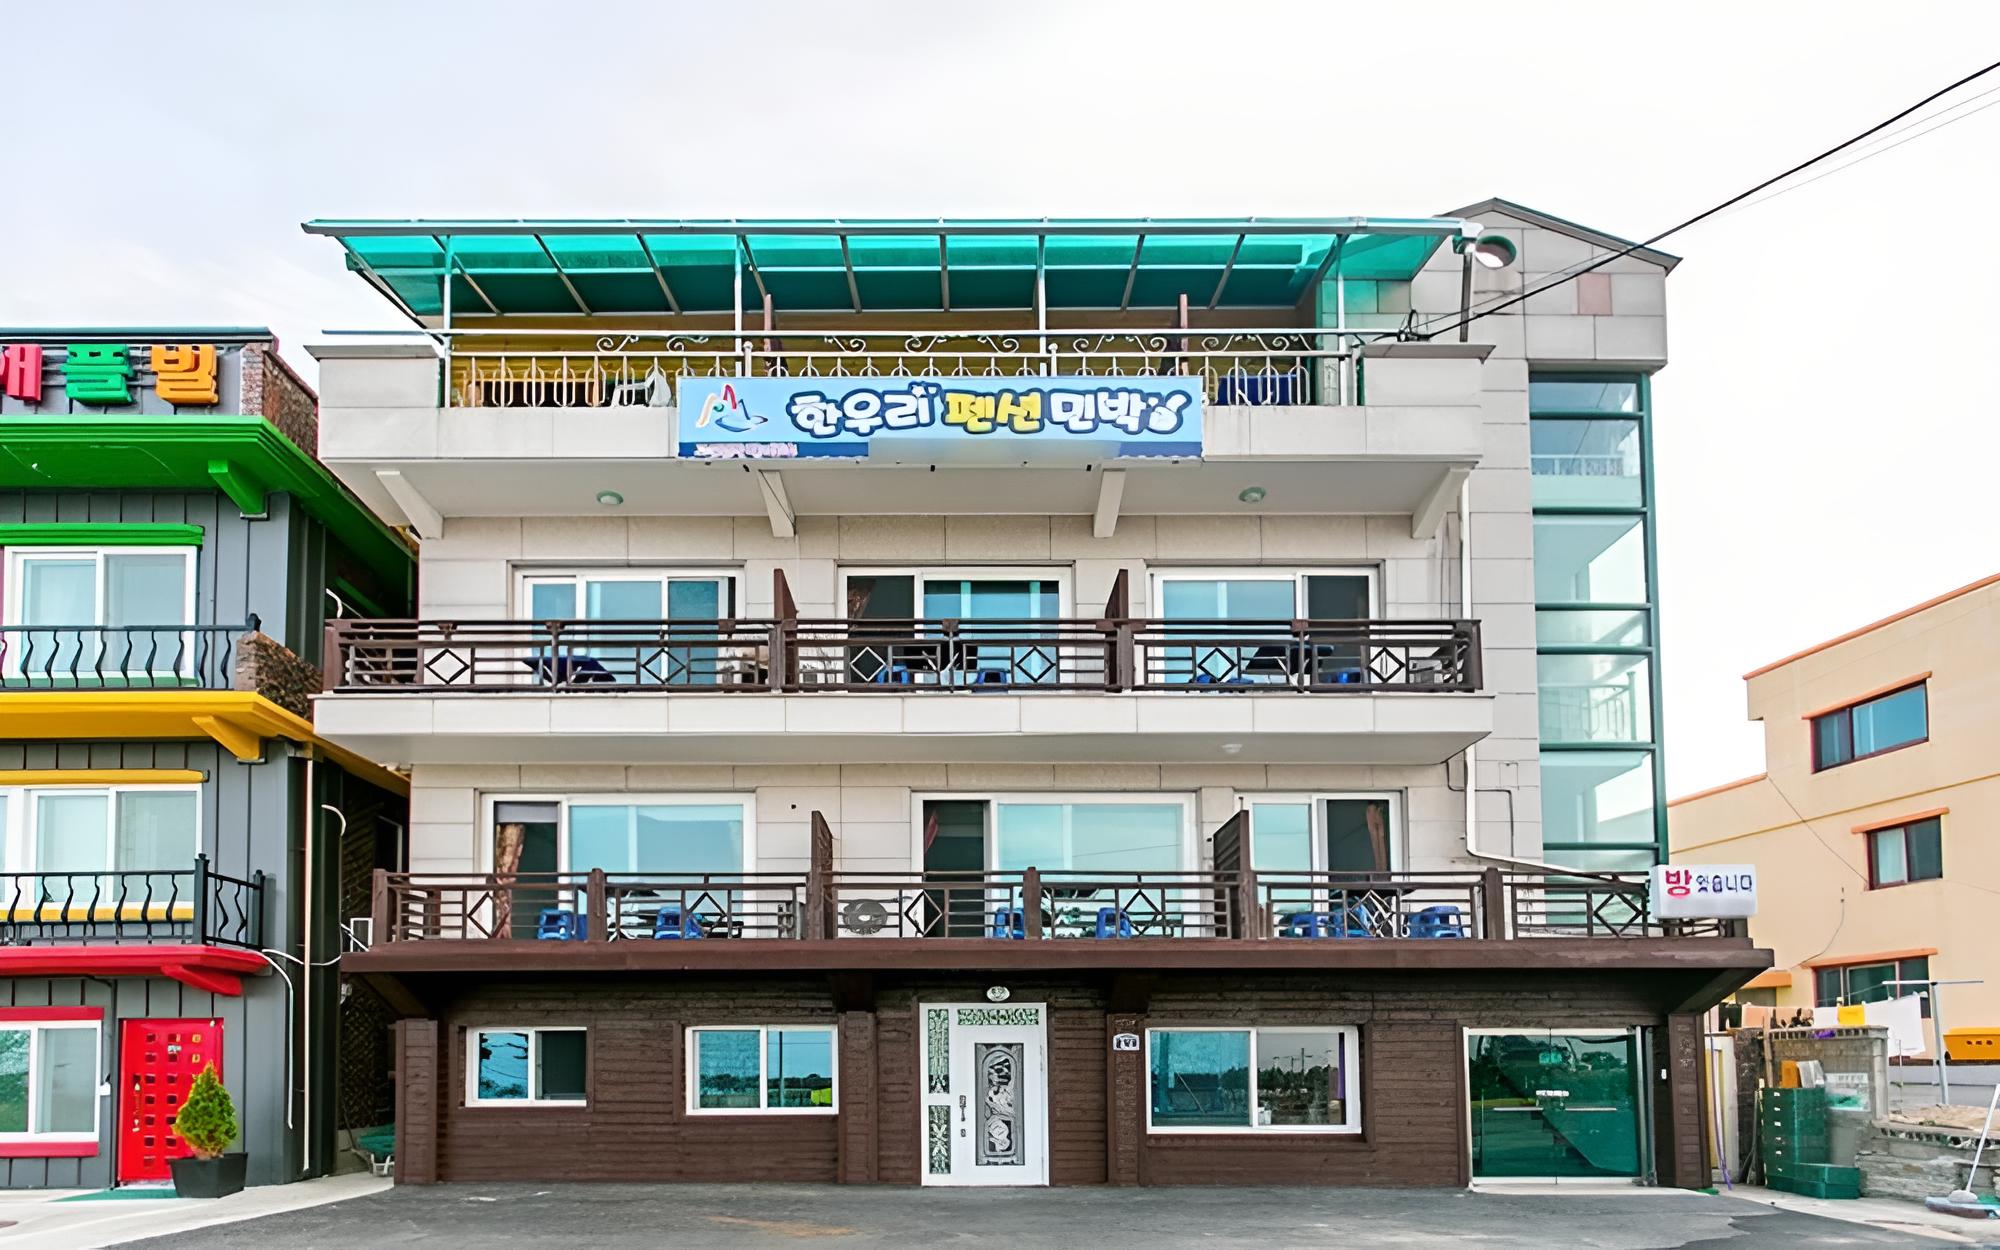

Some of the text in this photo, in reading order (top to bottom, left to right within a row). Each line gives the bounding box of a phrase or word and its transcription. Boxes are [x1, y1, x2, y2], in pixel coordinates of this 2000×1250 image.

[787, 382, 943, 438] 한우리
[942, 389, 1047, 434] 펜션
[1665, 869, 1692, 897] 방
